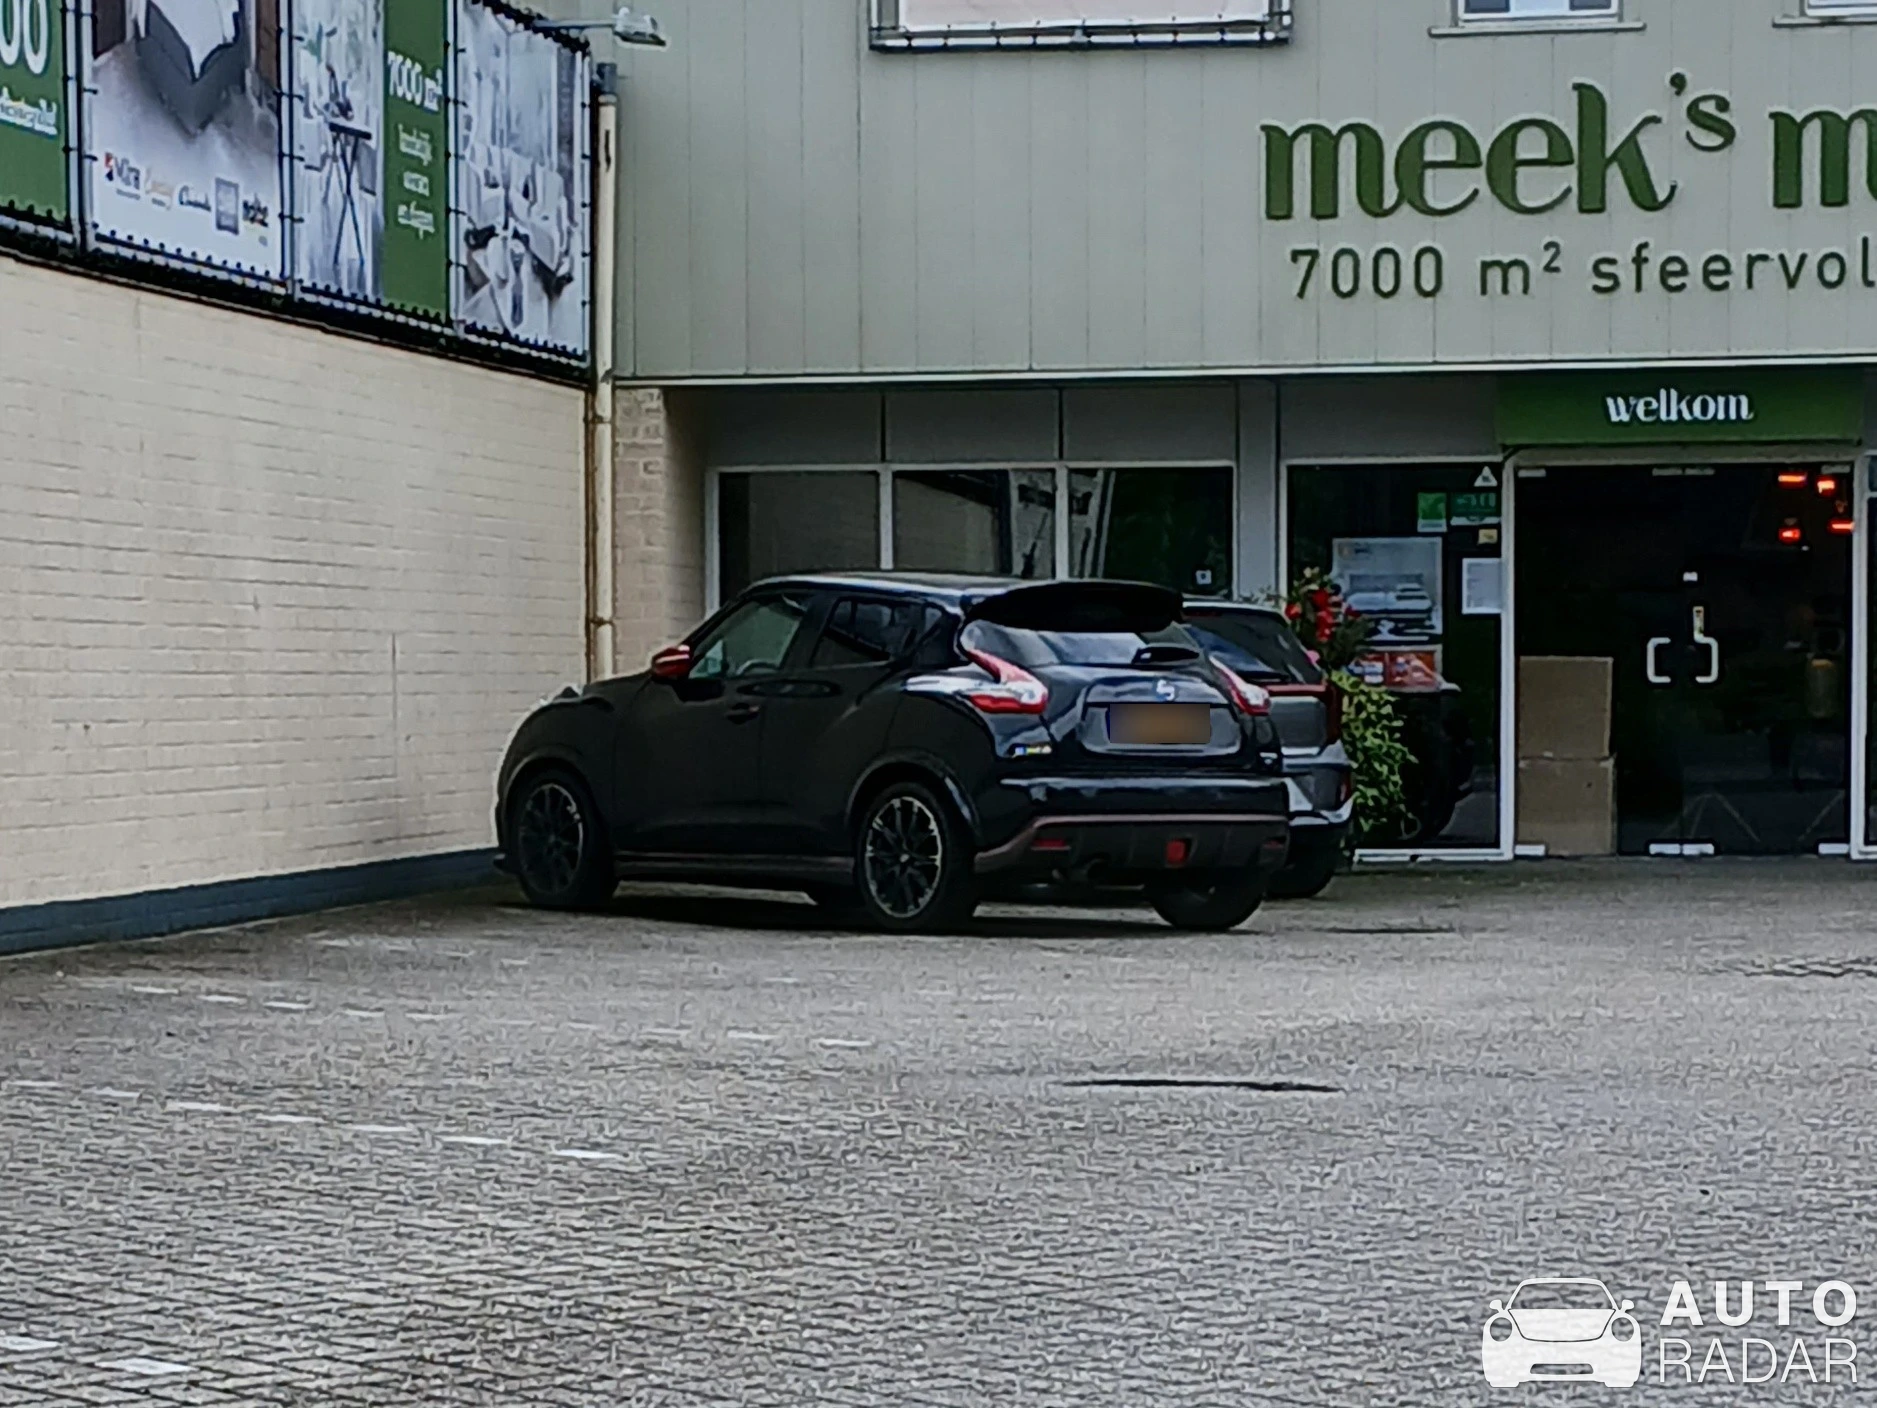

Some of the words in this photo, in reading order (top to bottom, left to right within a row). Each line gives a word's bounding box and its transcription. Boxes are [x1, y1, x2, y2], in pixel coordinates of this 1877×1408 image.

[1260, 72, 1736, 221] meek's
[1290, 245, 1443, 299] 7000
[1591, 236, 1877, 293] sfeervol
[1605, 388, 1754, 422] welkom
